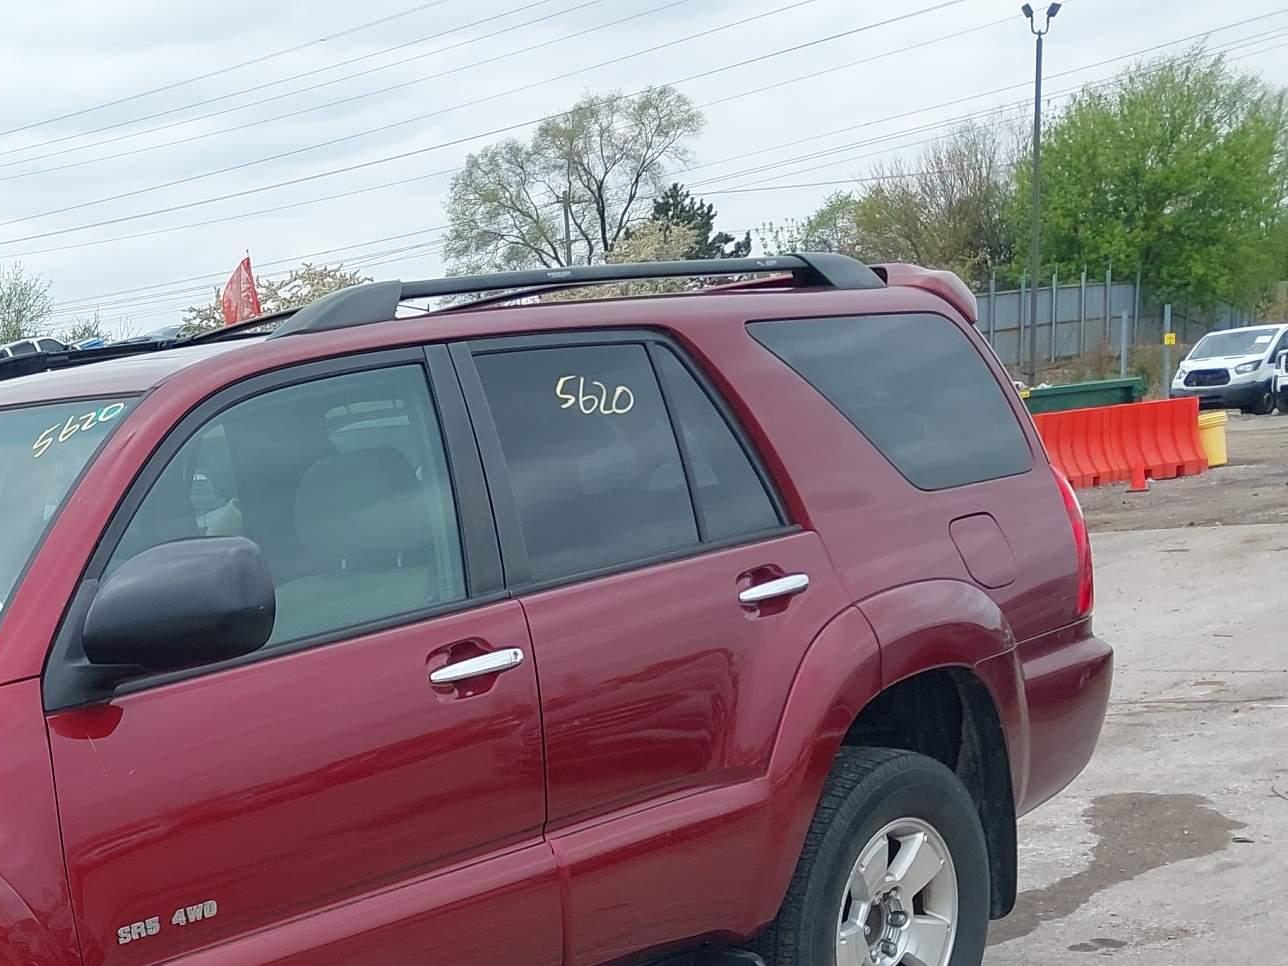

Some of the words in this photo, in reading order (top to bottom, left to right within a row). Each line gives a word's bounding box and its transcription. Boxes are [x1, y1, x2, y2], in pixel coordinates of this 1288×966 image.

[555, 375, 634, 414] 5620
[32, 402, 125, 458] 5620
[117, 916, 161, 945] SR5
[171, 899, 218, 926] 4WD
